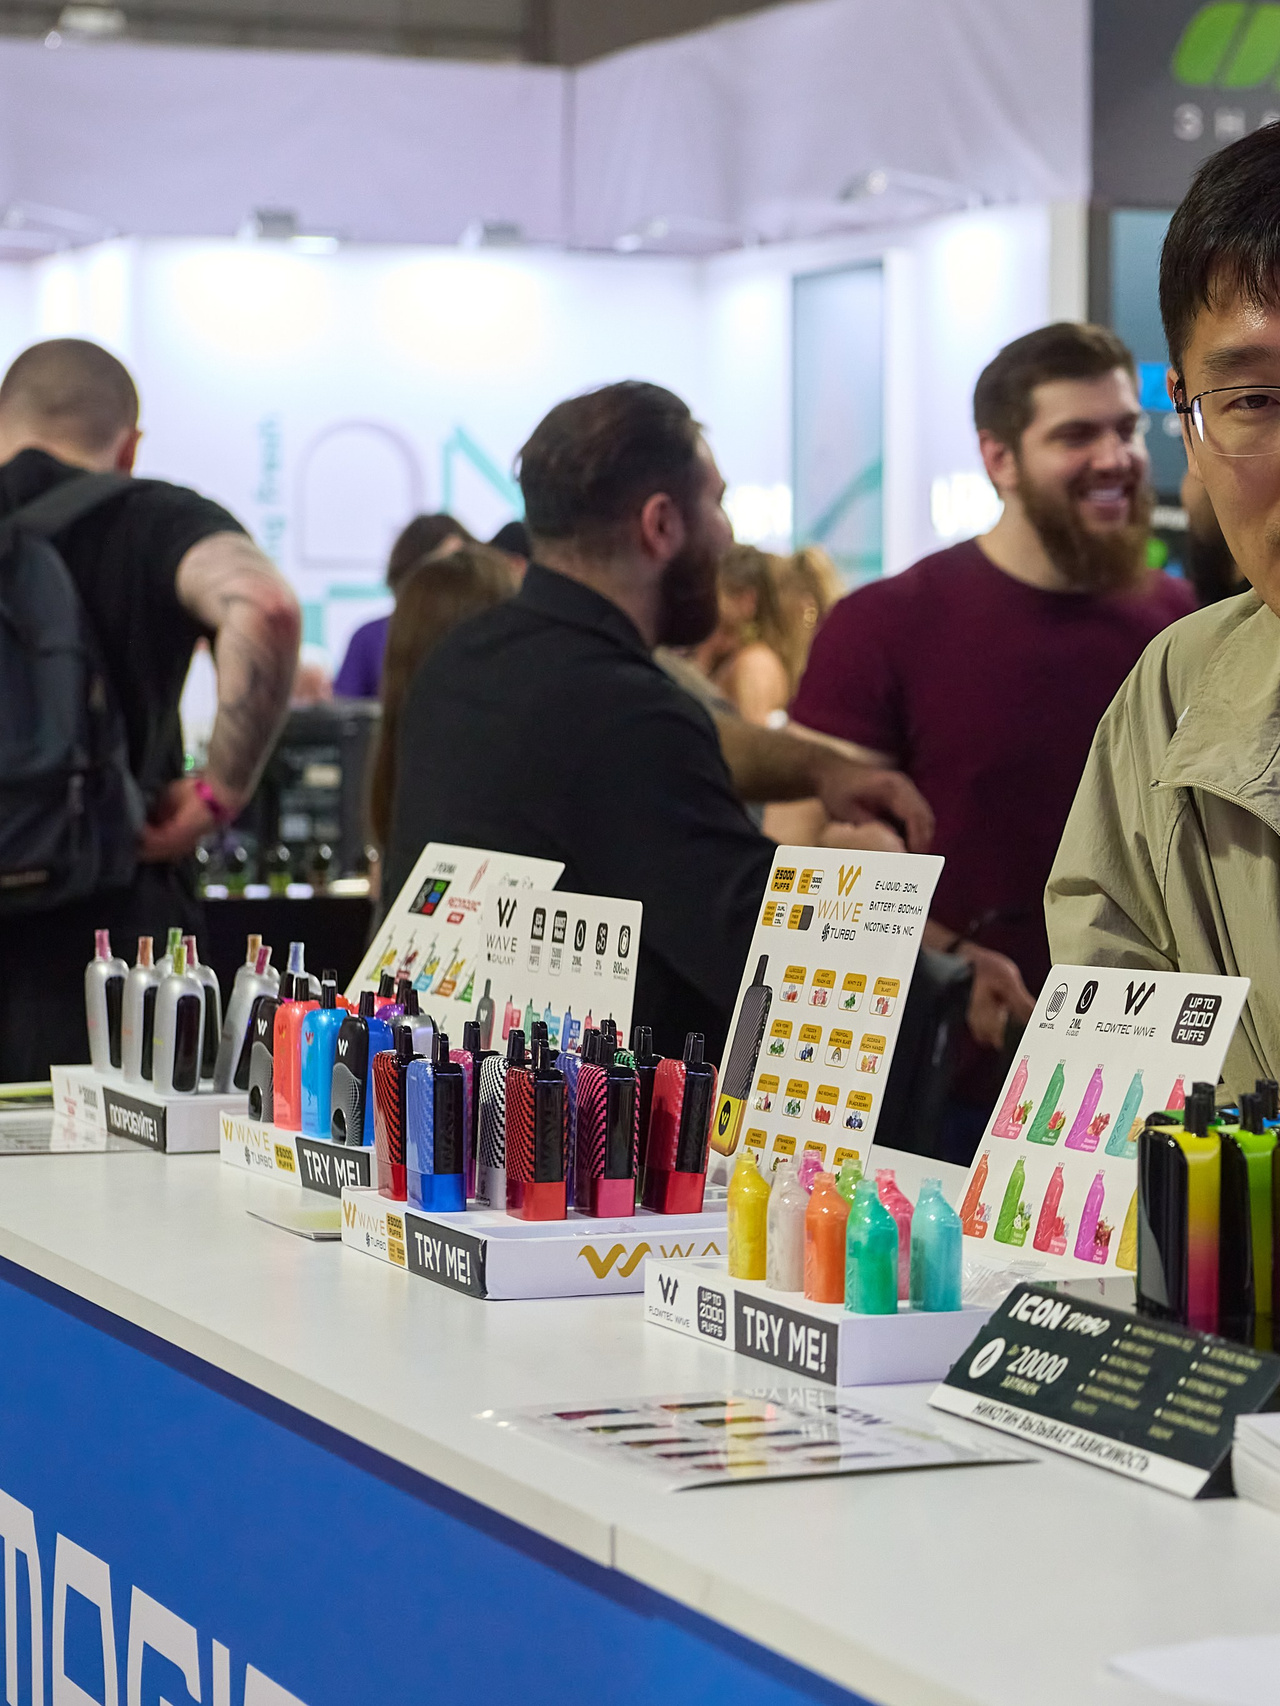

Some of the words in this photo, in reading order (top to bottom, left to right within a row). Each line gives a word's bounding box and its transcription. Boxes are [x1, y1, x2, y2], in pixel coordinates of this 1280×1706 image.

[775, 869, 795, 881] 25000
[774, 882, 790, 890] PUFFS
[818, 899, 863, 922] WAVE
[869, 900, 896, 912] BATTERY:
[830, 927, 856, 941] TURBO
[864, 921, 890, 933] NICOTINE:
[891, 924, 901, 934] 5%
[903, 926, 914, 936] NIC
[486, 932, 518, 953] WAVE
[1189, 997, 1201, 1009] UP
[1202, 998, 1215, 1010] TO
[1069, 1018, 1082, 1030] 2ML
[1179, 1010, 1213, 1028] 2000
[1095, 1021, 1131, 1035] FLOWTEC
[1134, 1025, 1156, 1038] WAVE
[1176, 1030, 1205, 1043] PUFFS
[234, 1123, 271, 1151] WAVE
[250, 1151, 273, 1169] TURBO
[303, 1149, 331, 1186] TRY
[357, 1211, 386, 1236] WAVE
[370, 1236, 386, 1251] TURBO
[414, 1231, 442, 1273] TRY
[445, 1243, 471, 1285] ME!
[701, 1290, 712, 1302] UP
[712, 1293, 722, 1306] TO
[648, 1305, 673, 1322] FLOWTEC
[700, 1302, 724, 1324] 2000
[1008, 1292, 1071, 1331] ICON
[701, 1320, 723, 1337] PUFFS
[742, 1305, 782, 1357] TRY
[788, 1321, 828, 1374] ME!
[1006, 1345, 1069, 1384] 20000
[972, 1400, 1019, 1428] НИКОТИН
[1018, 1414, 1076, 1443] ВЫЗЫВАЕТ
[1071, 1433, 1150, 1473] ЗАВИСИМОСТЬ
